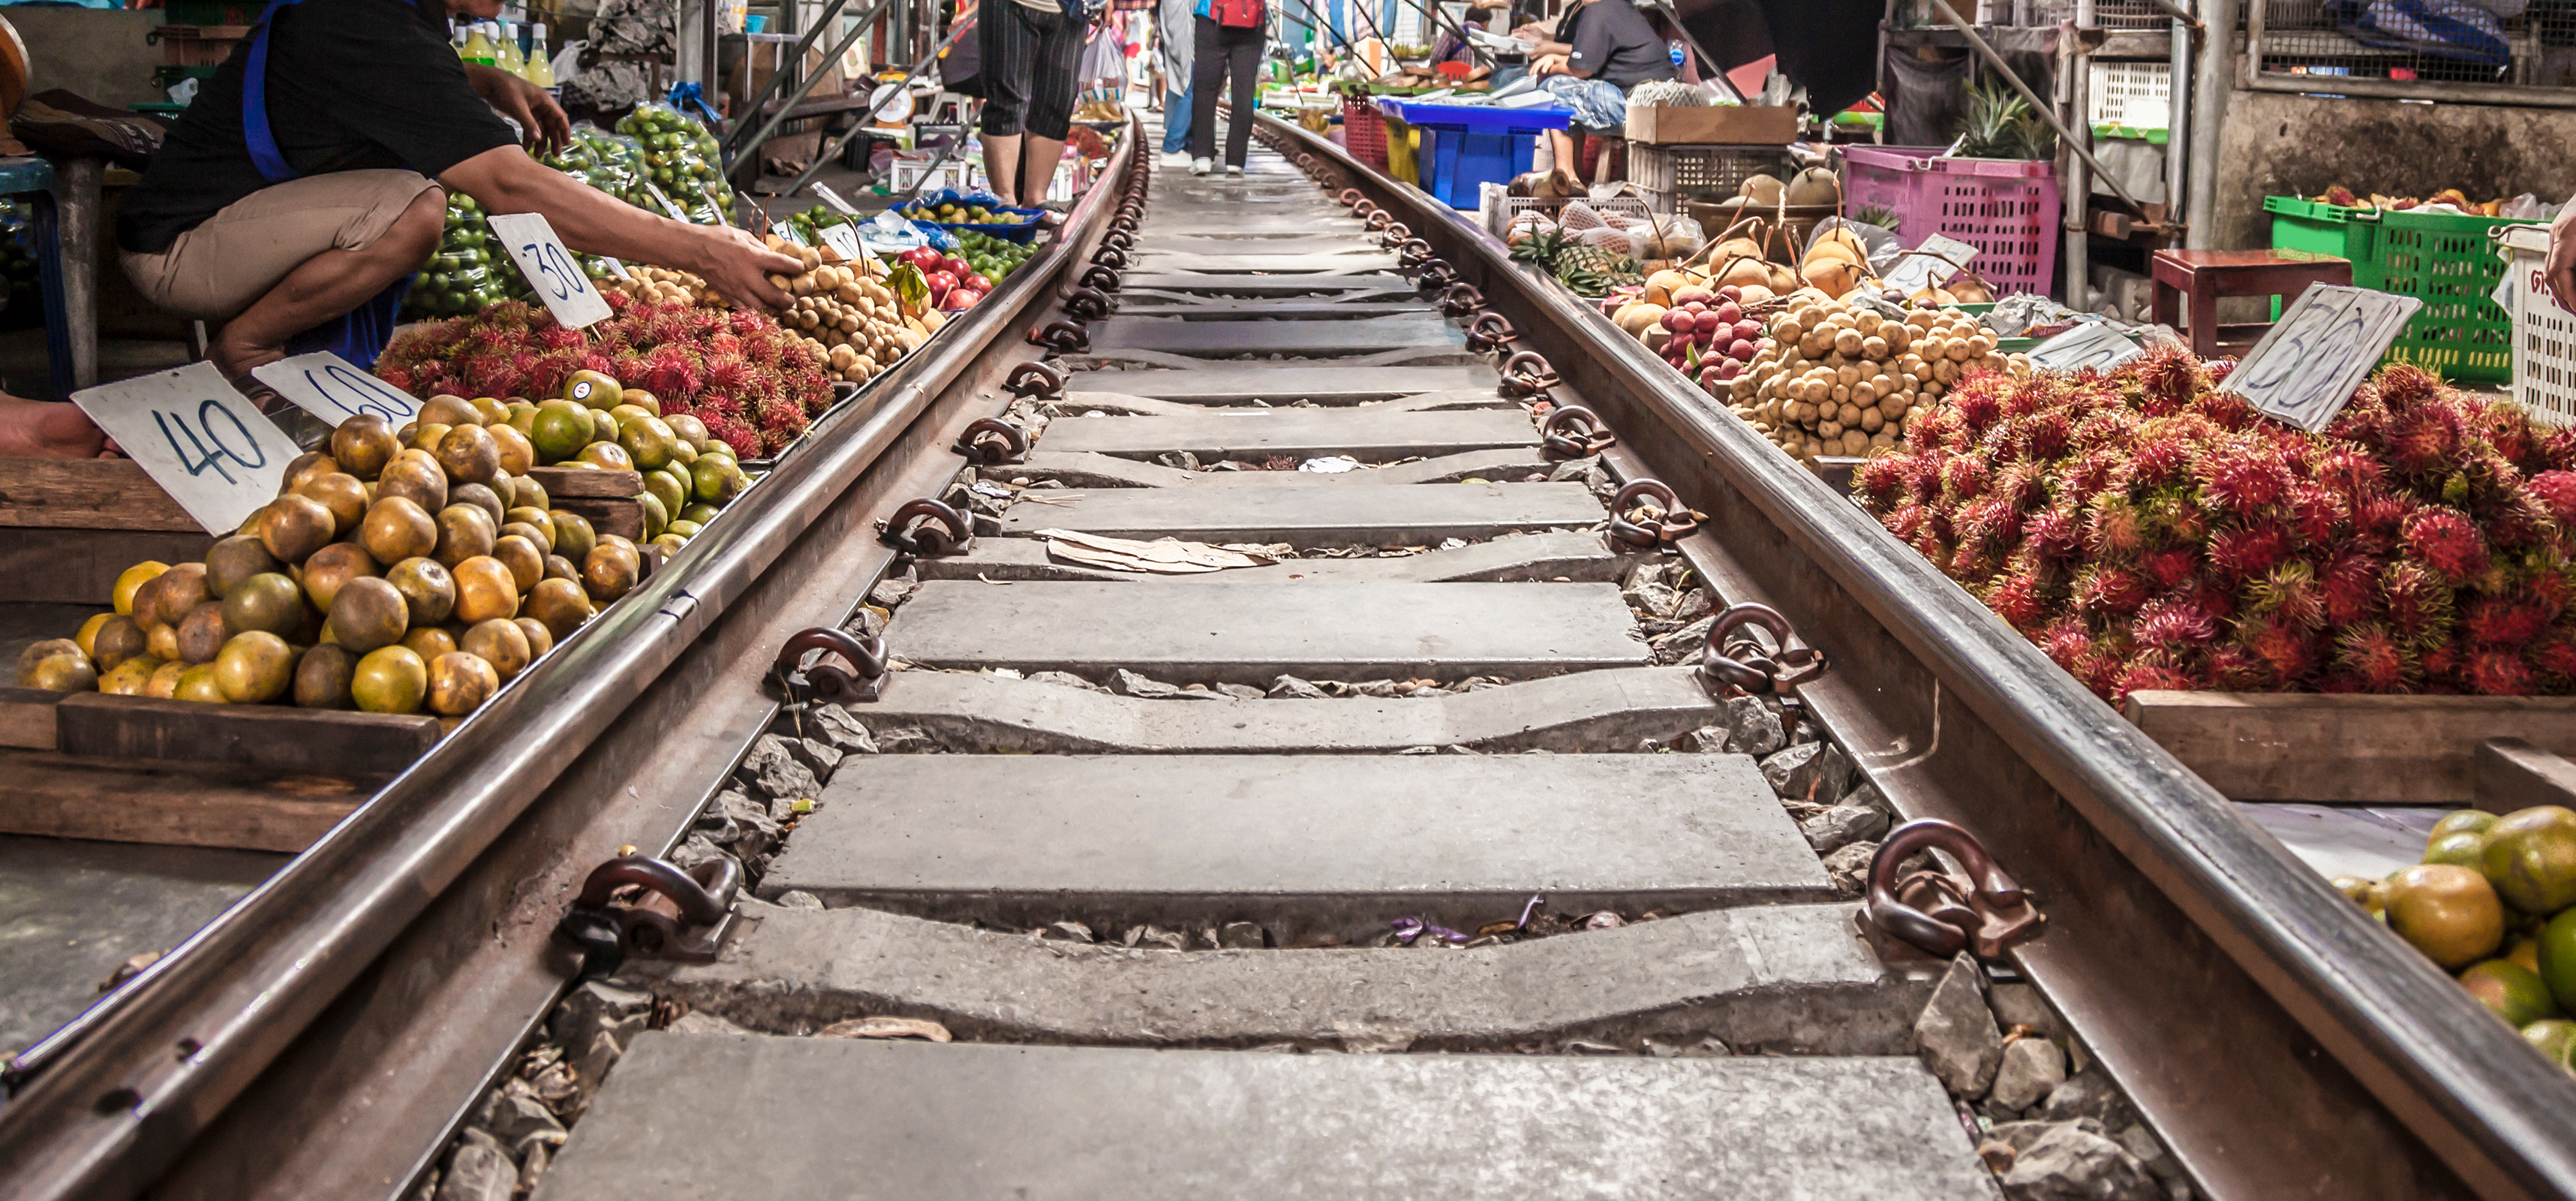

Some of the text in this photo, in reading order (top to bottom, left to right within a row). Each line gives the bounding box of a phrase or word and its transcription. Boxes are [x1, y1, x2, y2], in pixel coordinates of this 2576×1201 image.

[522, 242, 584, 301] 30
[836, 231, 871, 259] 10
[304, 365, 415, 424] 60
[151, 399, 266, 486] 40
